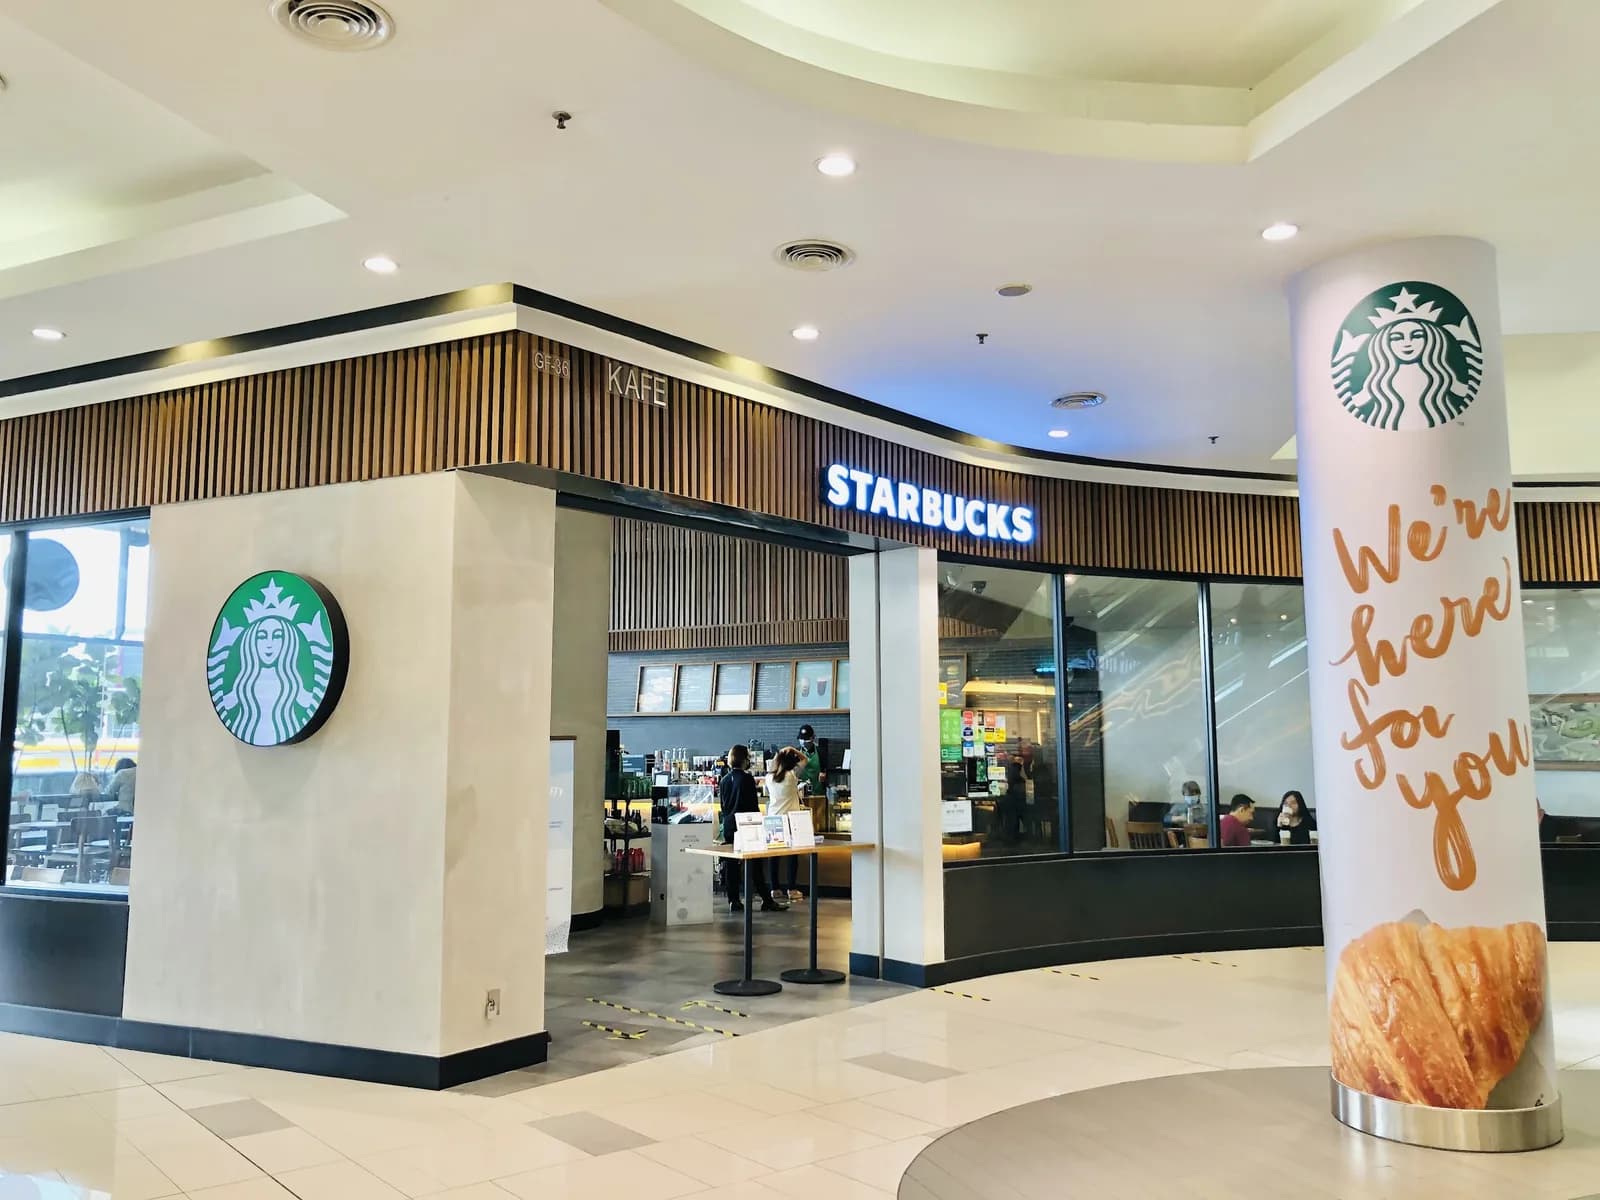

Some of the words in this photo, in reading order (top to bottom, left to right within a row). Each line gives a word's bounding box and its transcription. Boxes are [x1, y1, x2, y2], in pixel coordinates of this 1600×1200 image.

[534, 352, 569, 377] GF-36
[607, 362, 667, 407] KAFE
[827, 463, 1034, 543] STARBUCKS
[1332, 484, 1512, 594] We're
[1328, 556, 1512, 686] here
[1340, 677, 1456, 790] for
[1395, 718, 1530, 892] you
